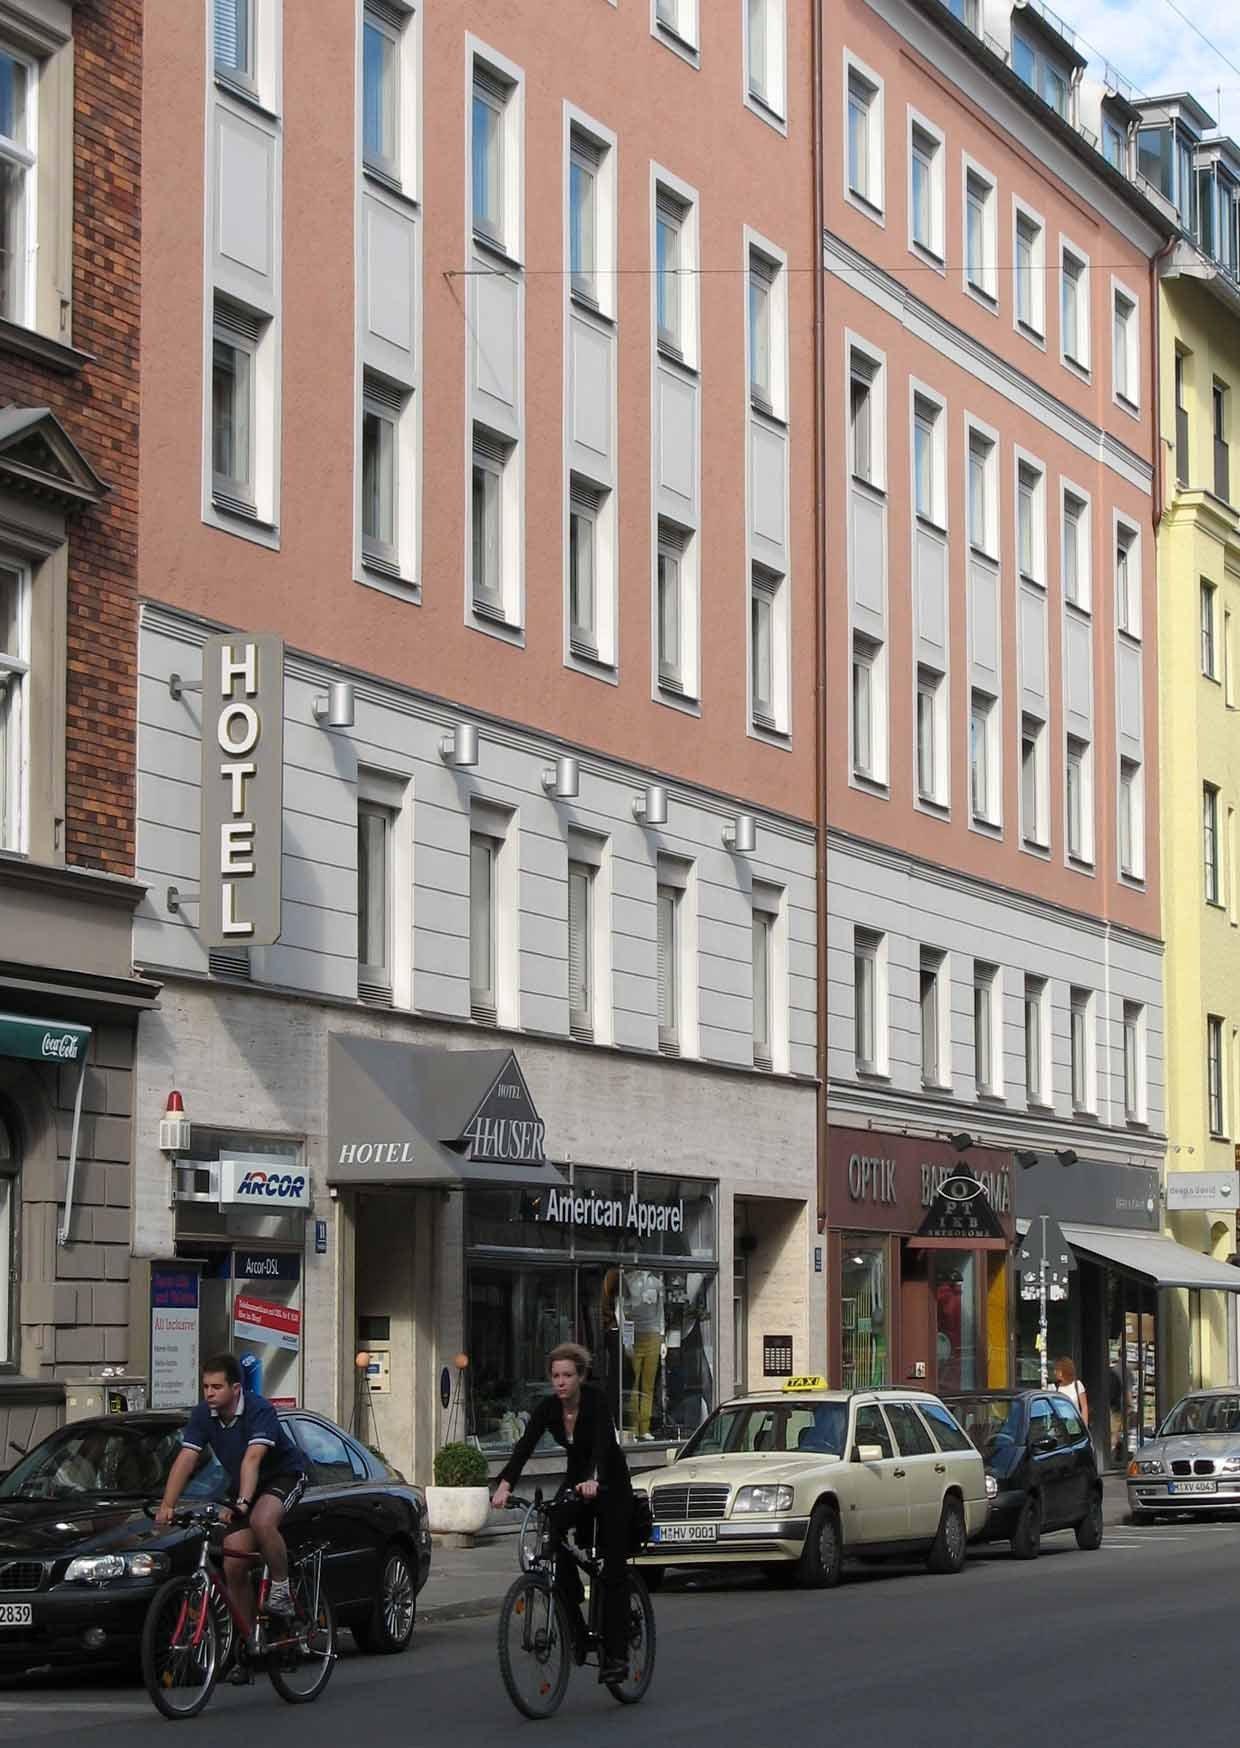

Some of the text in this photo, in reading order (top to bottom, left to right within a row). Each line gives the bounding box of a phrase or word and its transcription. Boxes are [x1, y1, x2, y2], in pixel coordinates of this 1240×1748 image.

[217, 643, 260, 936] HOTEL
[498, 1084, 522, 1100] HOTEL
[470, 1117, 546, 1161] HAUSER
[338, 1143, 415, 1164] HOTEL
[237, 1171, 305, 1198] ARCOR
[849, 1153, 897, 1202] OPTIK
[546, 1188, 684, 1237] American Apparel
[245, 1257, 279, 1275] Arcor-DSL
[788, 1377, 820, 1387] TAXI
[688, 1526, 715, 1539] 9001
[0, 1606, 30, 1623] 2839
